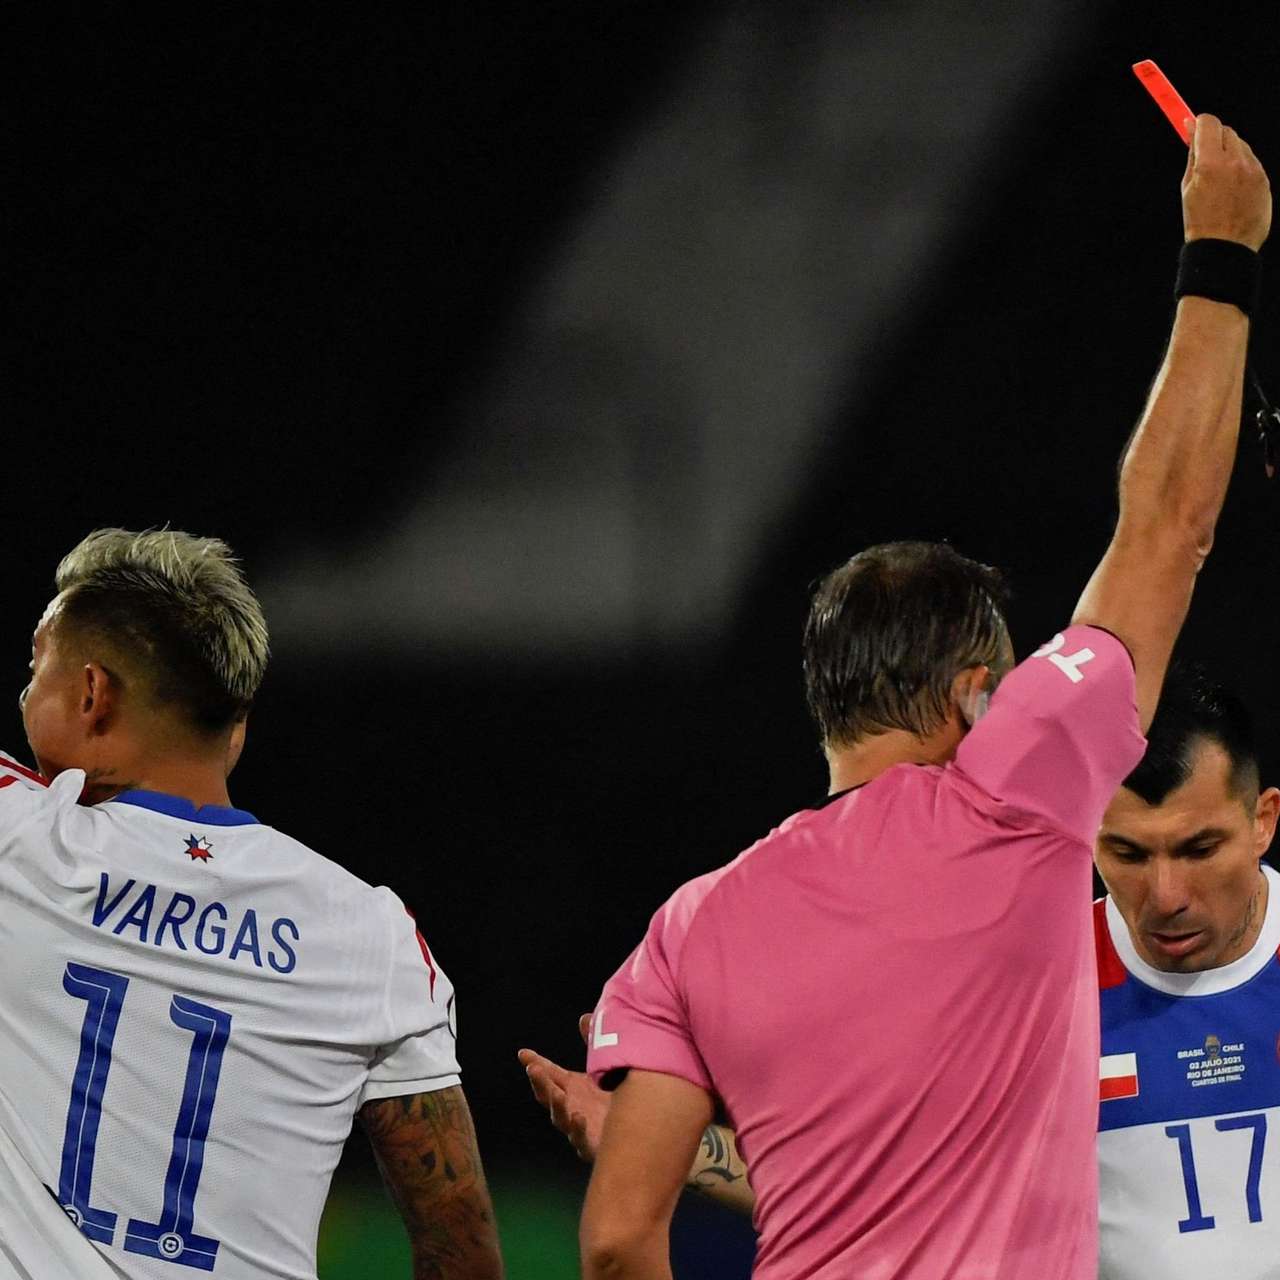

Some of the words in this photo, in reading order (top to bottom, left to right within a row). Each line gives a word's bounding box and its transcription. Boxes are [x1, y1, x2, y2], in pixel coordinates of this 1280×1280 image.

[90, 872, 300, 974] VARGAS
[1177, 1048, 1206, 1060] BRASIL
[1222, 1043, 1245, 1053] CHILE
[1186, 1070, 1201, 1080] RIO
[1201, 1069, 1213, 1078] DE
[1213, 1064, 1246, 1076] JANEIRO
[1200, 1058, 1223, 1069] JULIO
[1223, 1055, 1242, 1065] 2021
[59, 961, 233, 1272] 11
[1165, 1113, 1268, 1234] 17
